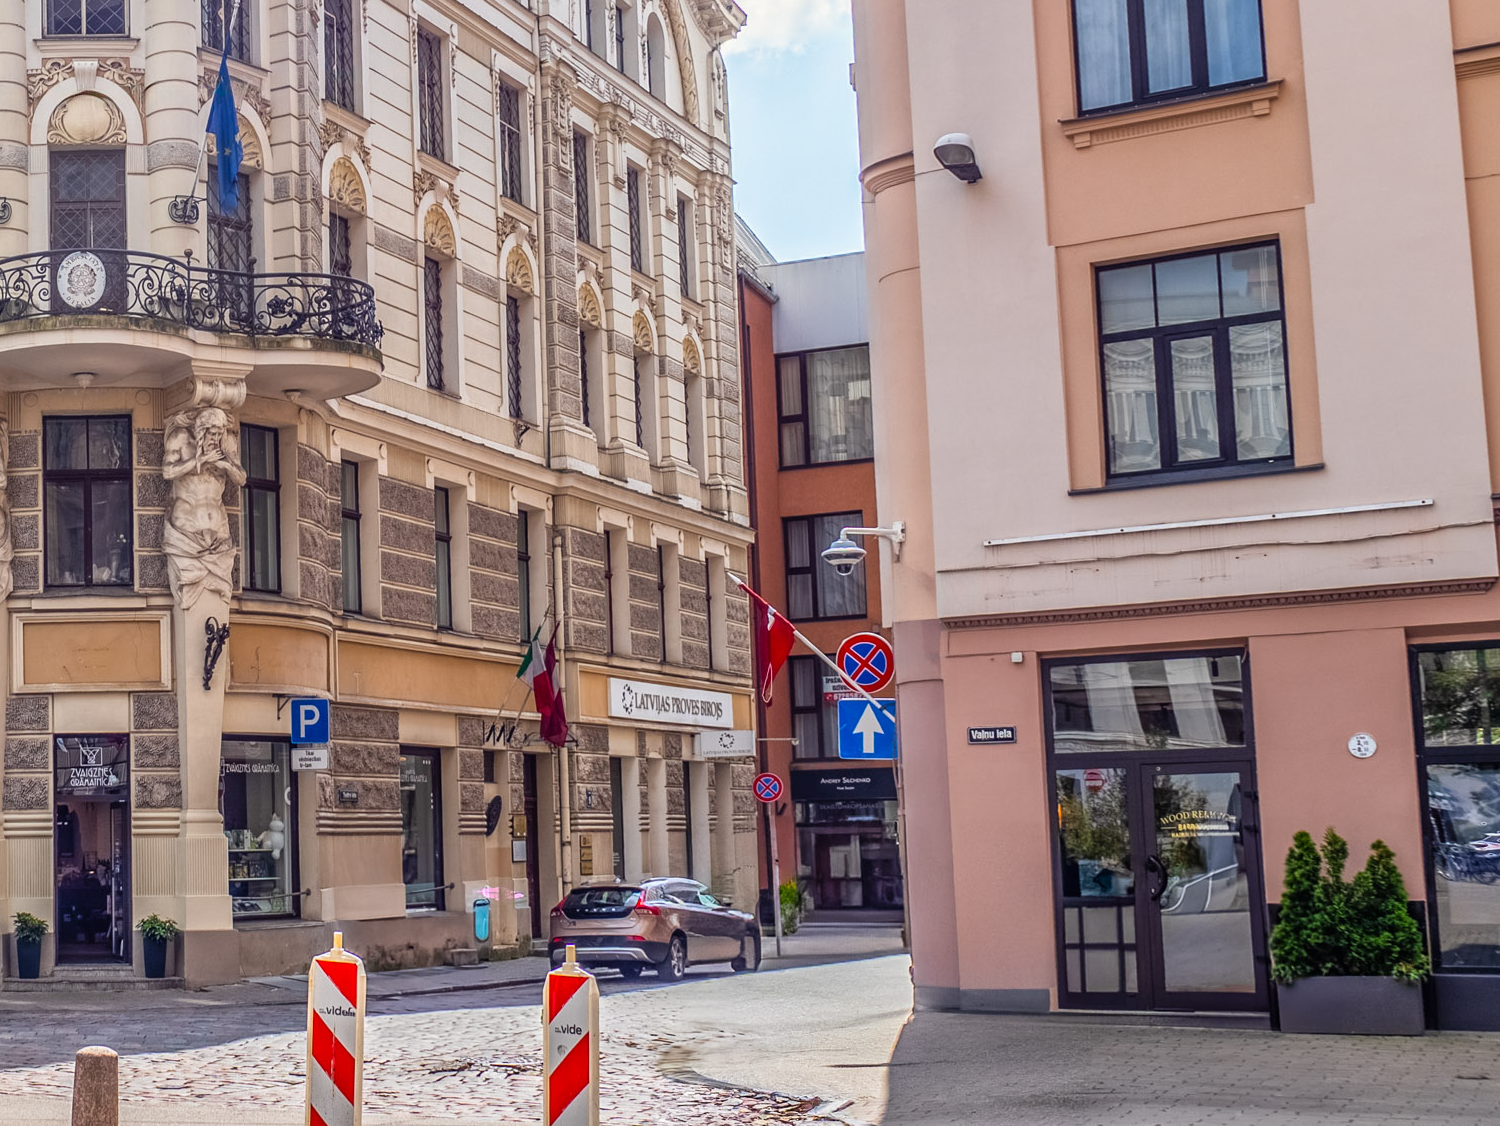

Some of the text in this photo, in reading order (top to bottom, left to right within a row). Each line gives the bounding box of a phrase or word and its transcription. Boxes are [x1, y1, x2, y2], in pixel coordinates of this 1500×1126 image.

[634, 692, 723, 720] LATVIJAS PROVES BIROJS
[300, 705, 320, 738] P
[996, 729, 1012, 739] iela
[70, 767, 113, 778] ZVAIGZNES
[1160, 811, 1190, 825] WOOD
